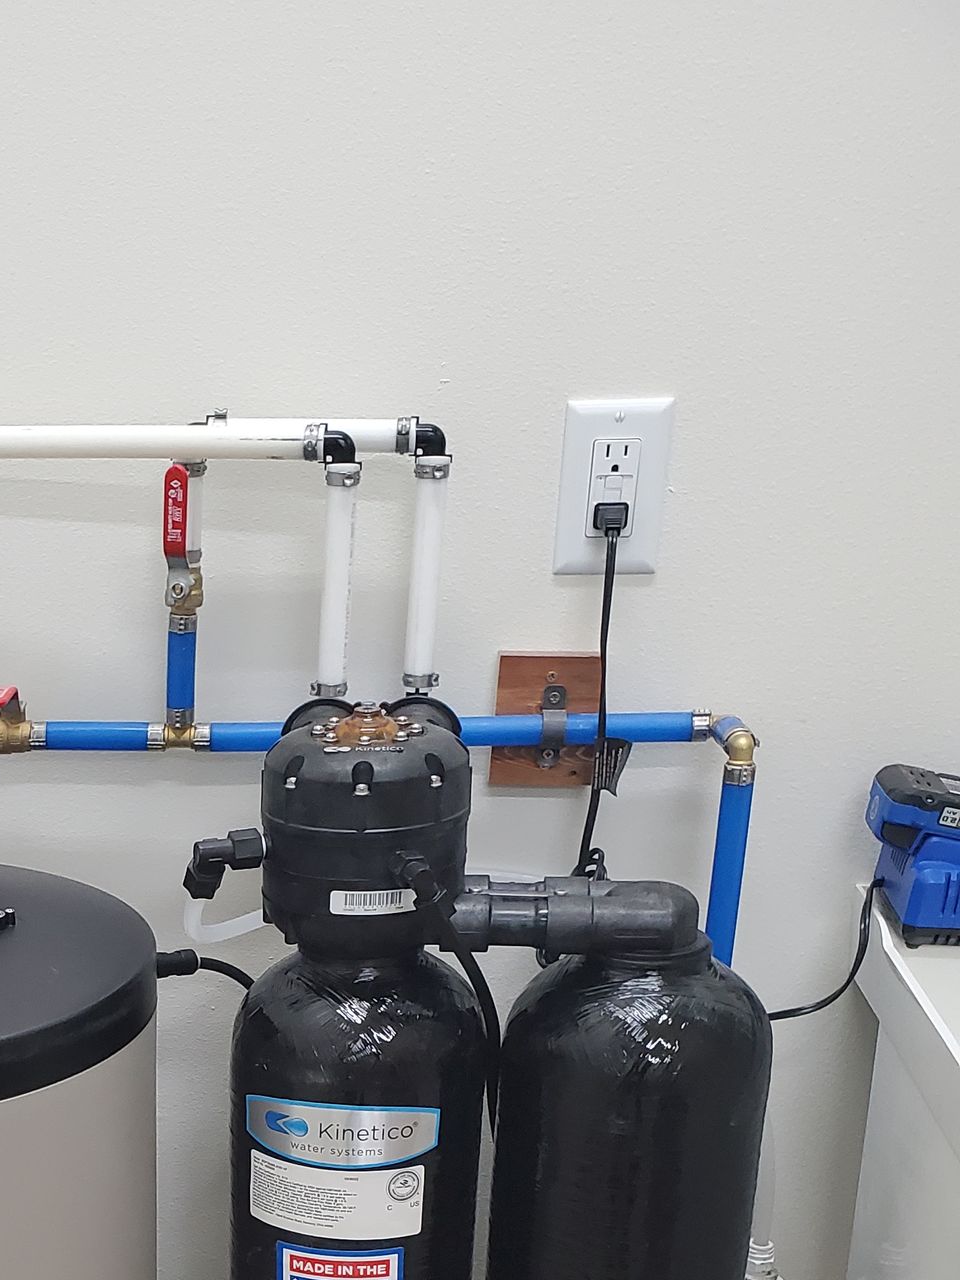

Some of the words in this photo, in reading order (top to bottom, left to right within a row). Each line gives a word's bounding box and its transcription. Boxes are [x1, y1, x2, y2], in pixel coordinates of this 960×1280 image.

[319, 1122, 414, 1141] Kinetico
[290, 1141, 325, 1153] water
[330, 1147, 383, 1157] systems
[292, 1259, 334, 1275] MADE
[337, 1265, 353, 1275] IN
[357, 1264, 387, 1276] THE
